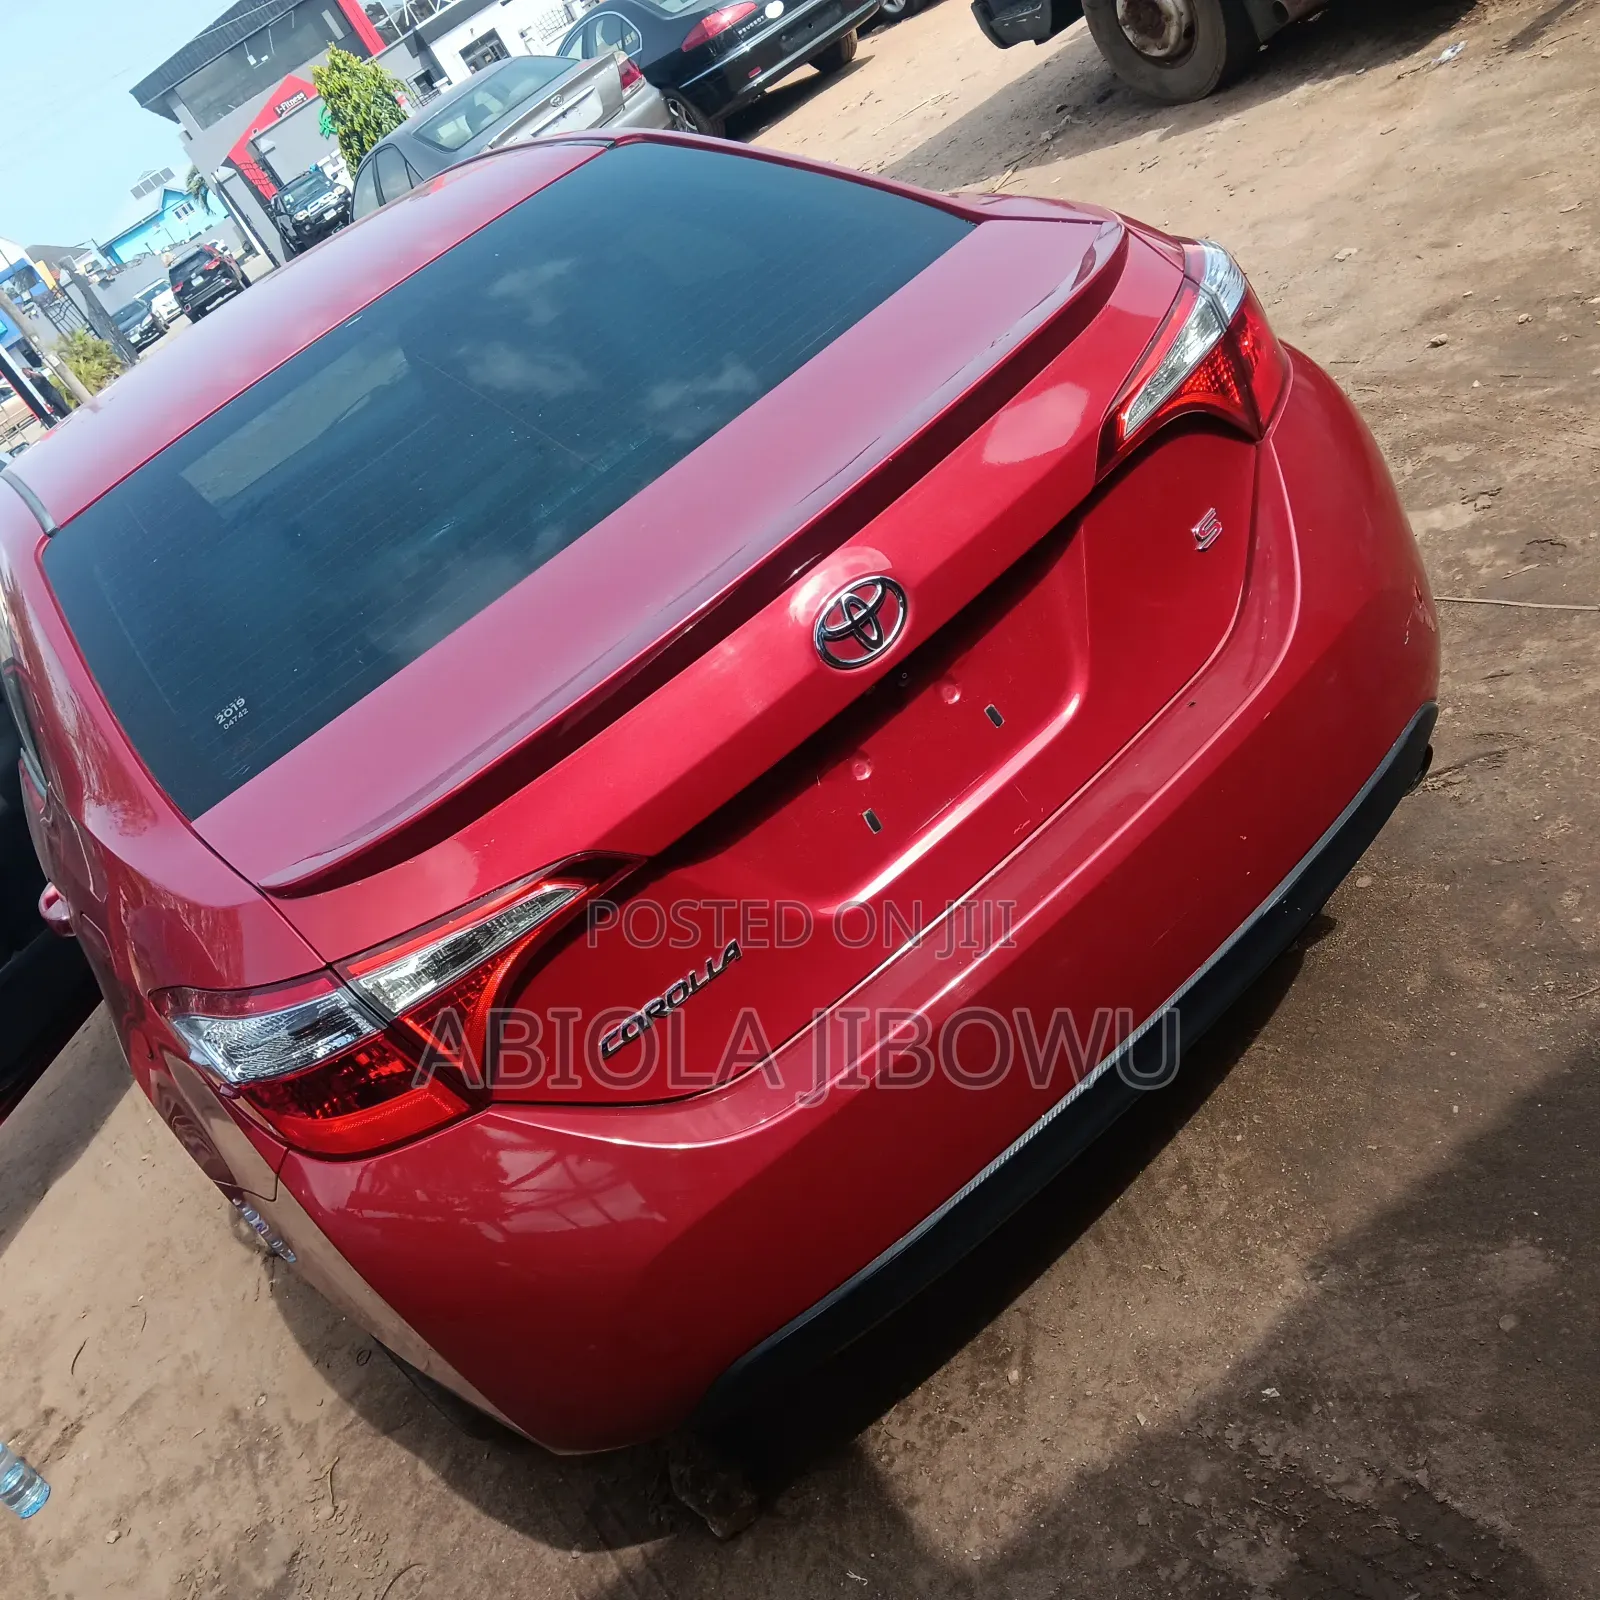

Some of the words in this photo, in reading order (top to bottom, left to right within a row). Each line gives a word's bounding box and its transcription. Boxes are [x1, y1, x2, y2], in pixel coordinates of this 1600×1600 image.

[1191, 507, 1223, 552] S
[216, 698, 245, 724] 2019
[223, 708, 249, 729] 04742
[598, 937, 743, 1060] COROLLA
